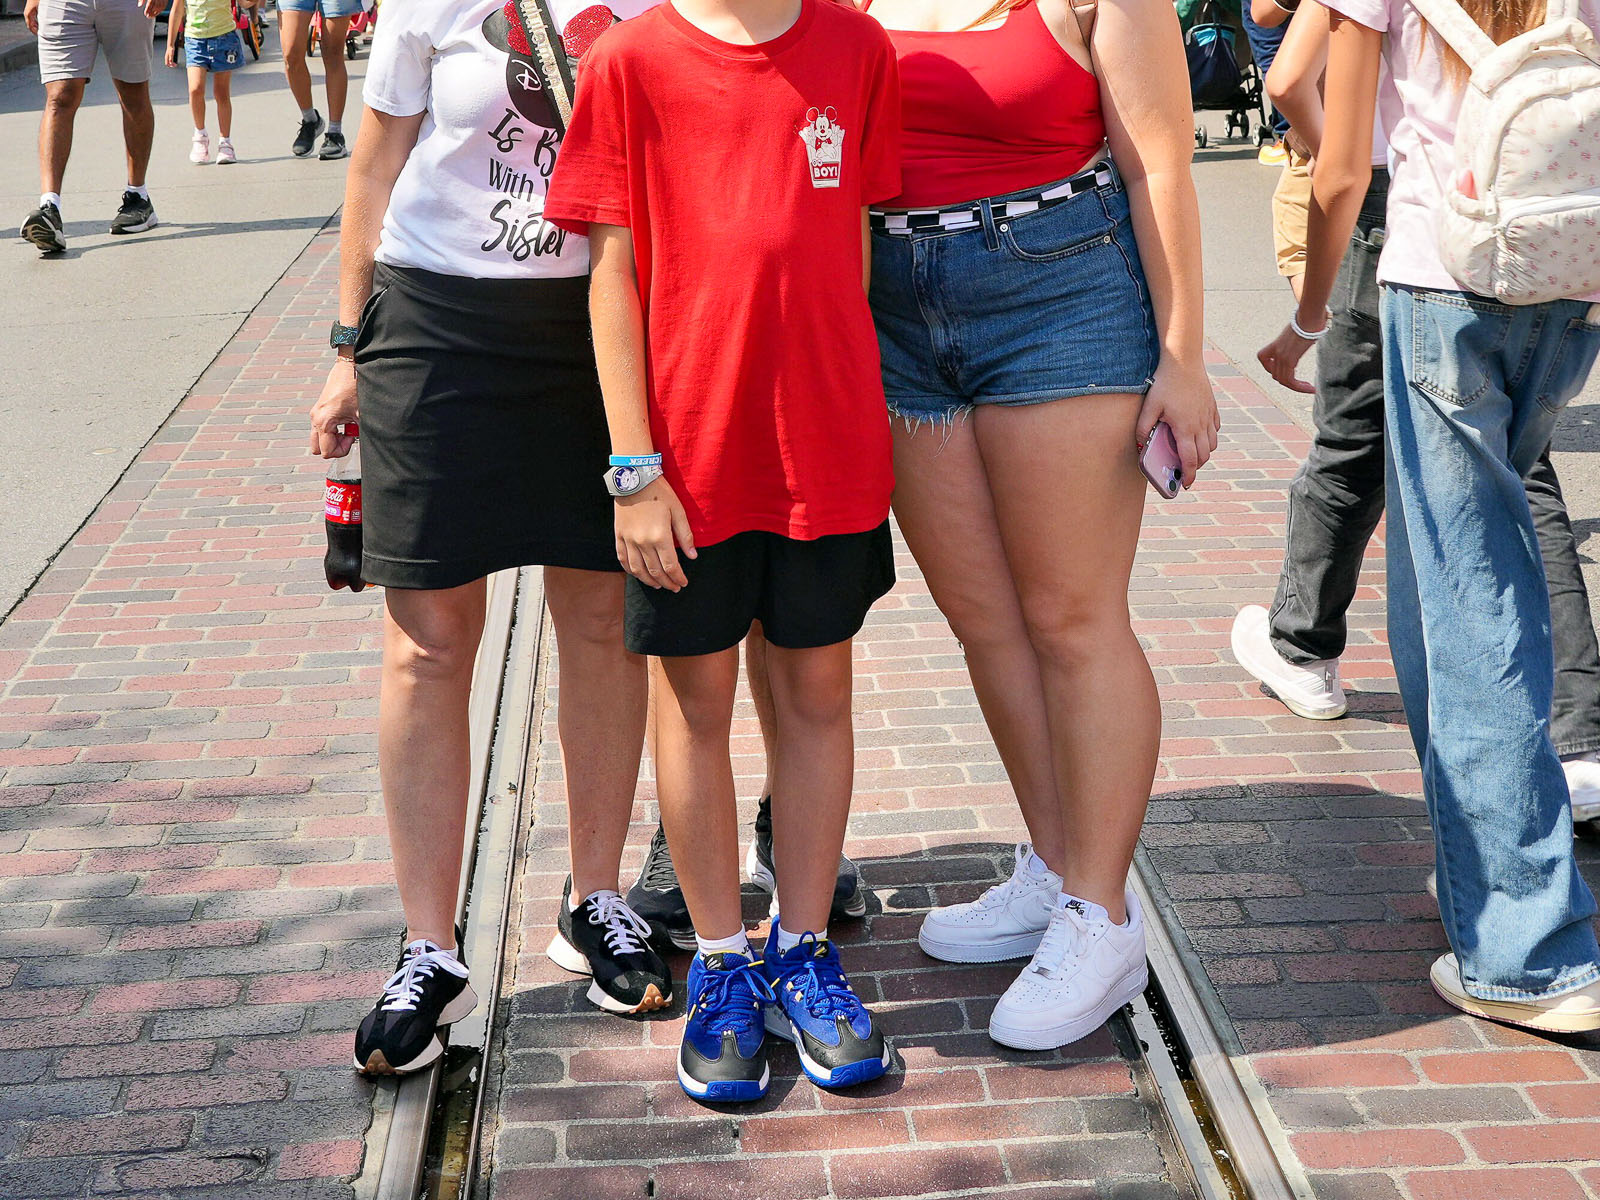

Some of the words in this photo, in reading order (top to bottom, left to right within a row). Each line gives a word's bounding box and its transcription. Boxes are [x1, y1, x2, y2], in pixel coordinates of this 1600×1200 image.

[488, 108, 524, 153] Is
[489, 157, 534, 203] With
[813, 166, 838, 177] BOY!
[480, 199, 567, 261] Sister
